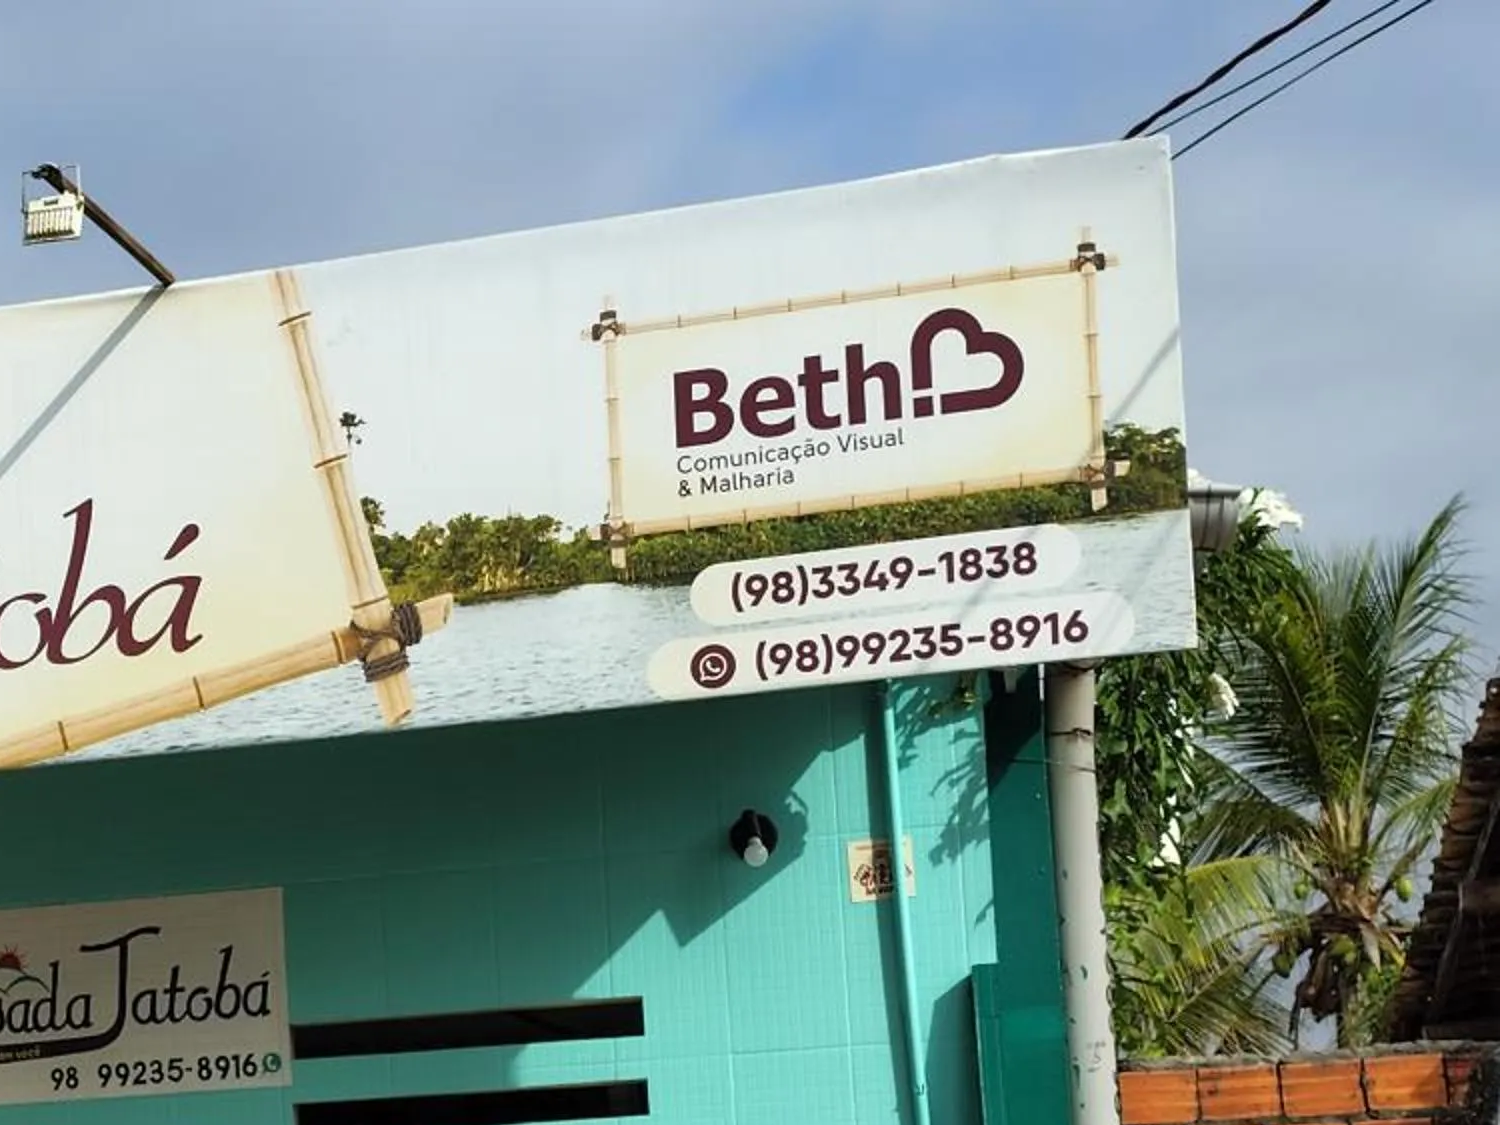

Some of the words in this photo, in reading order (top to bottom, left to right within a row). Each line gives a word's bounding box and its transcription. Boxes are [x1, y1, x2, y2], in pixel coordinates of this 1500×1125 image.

[676, 438, 831, 475] Comunicação
[838, 427, 905, 453] Visual
[678, 479, 693, 498] &
[700, 467, 796, 495] Malharia
[731, 541, 1038, 613] (98)3349-1838
[755, 609, 1090, 682] (98)99235-8916
[79, 926, 272, 1050] Jatobá
[50, 1066, 80, 1091] 98
[98, 1052, 260, 1088] 99235-8916
